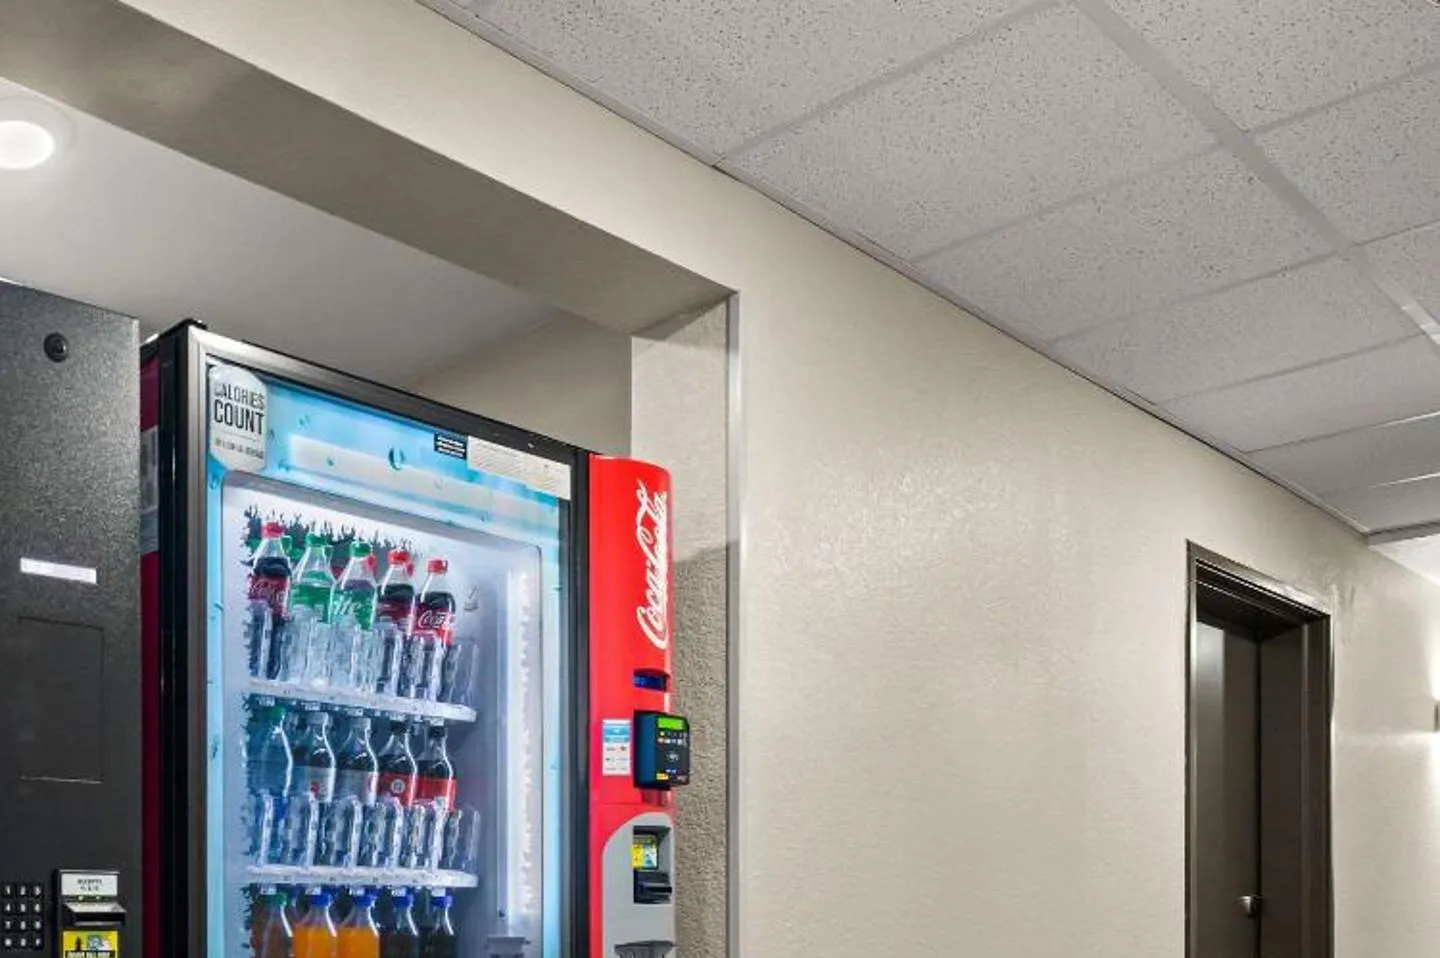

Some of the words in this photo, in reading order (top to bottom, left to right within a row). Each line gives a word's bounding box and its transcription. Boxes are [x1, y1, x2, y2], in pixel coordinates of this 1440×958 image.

[214, 383, 265, 411] CALORIES
[214, 398, 265, 435] COUNT
[636, 478, 669, 650] Coca-Cola
